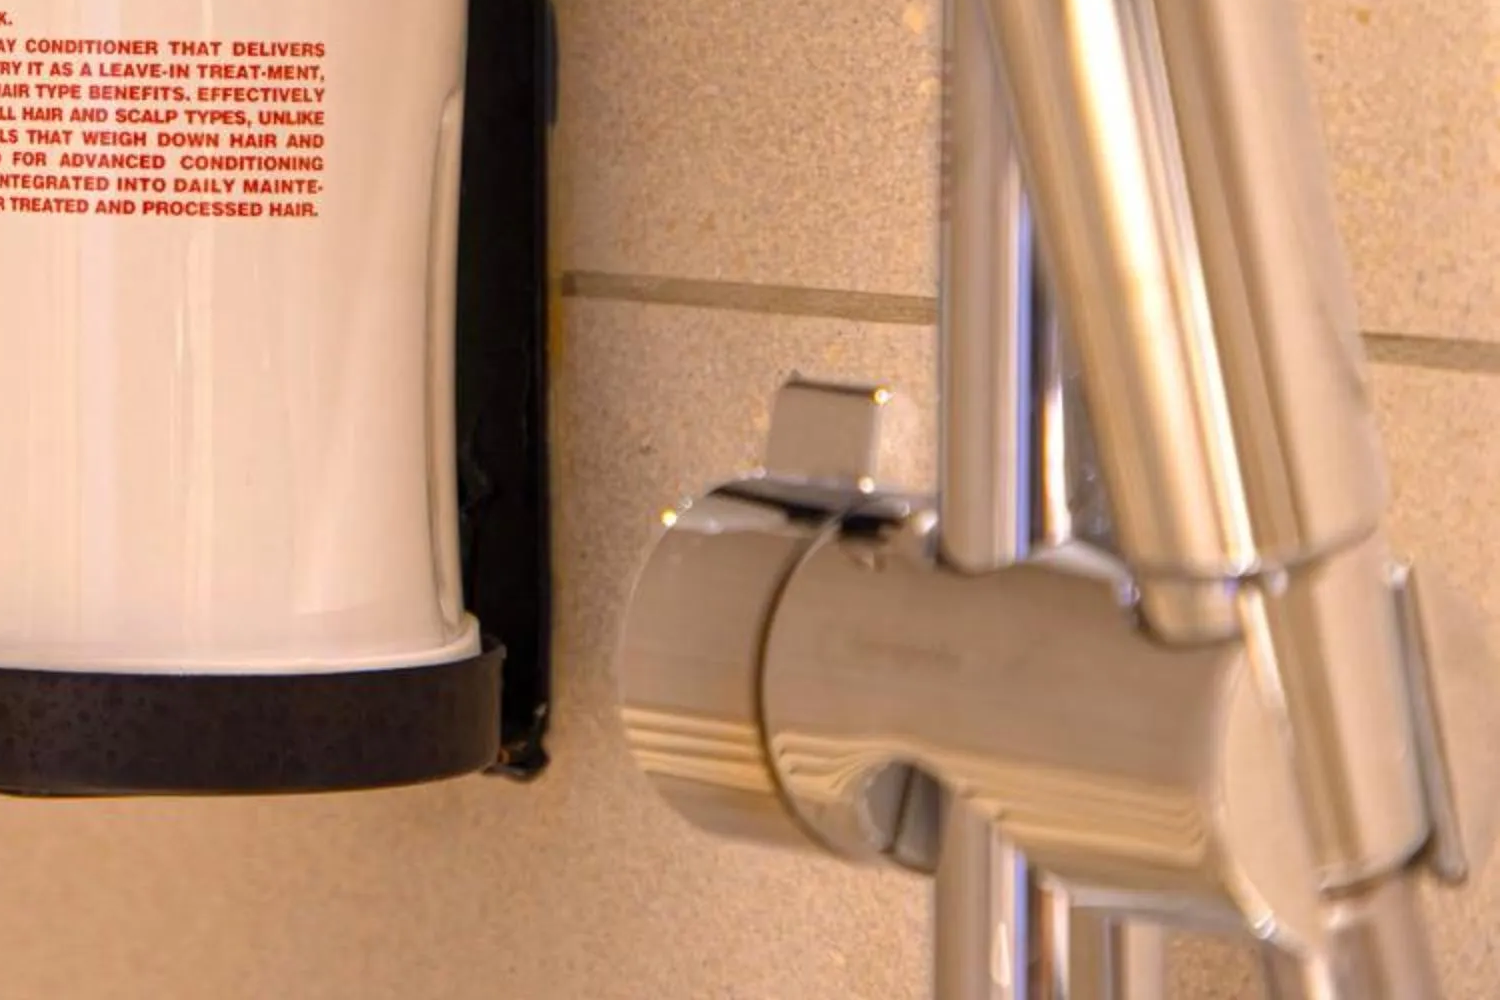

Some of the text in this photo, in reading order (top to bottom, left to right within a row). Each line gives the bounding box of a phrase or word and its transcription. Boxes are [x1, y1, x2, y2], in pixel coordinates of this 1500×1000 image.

[25, 38, 158, 55] CONDITIONER
[168, 41, 222, 56] THAT
[233, 41, 325, 57] DELIVERS
[27, 62, 43, 76] IT
[49, 62, 73, 77] AS
[80, 62, 92, 77] A
[100, 63, 189, 79] LEAVE-IN
[35, 84, 81, 99] TYPE
[89, 85, 190, 101] BENEFITS.
[197, 86, 325, 103] EFFECTIVELY
[22, 106, 62, 121] HAIR
[69, 107, 108, 122] AND
[115, 108, 178, 124] SCALP
[184, 110, 252, 128] TYPES,
[258, 110, 325, 125] UNLIKE
[26, 129, 72, 145] THAT
[82, 130, 147, 147] WEIGH
[157, 132, 219, 148] DOWN
[229, 133, 277, 149] HAIR
[286, 133, 324, 149] AND
[12, 151, 47, 166] FOR
[60, 152, 165, 169] ADVANCED
[180, 155, 324, 171] CONDITIONING
[117, 177, 166, 192] INTO
[173, 178, 234, 193] DAILY
[243, 179, 323, 194] MAINTE-
[10, 196, 89, 213] TREATED
[95, 199, 136, 215] AND
[142, 200, 263, 217] PROCESSED
[269, 202, 319, 217] HAIR.
